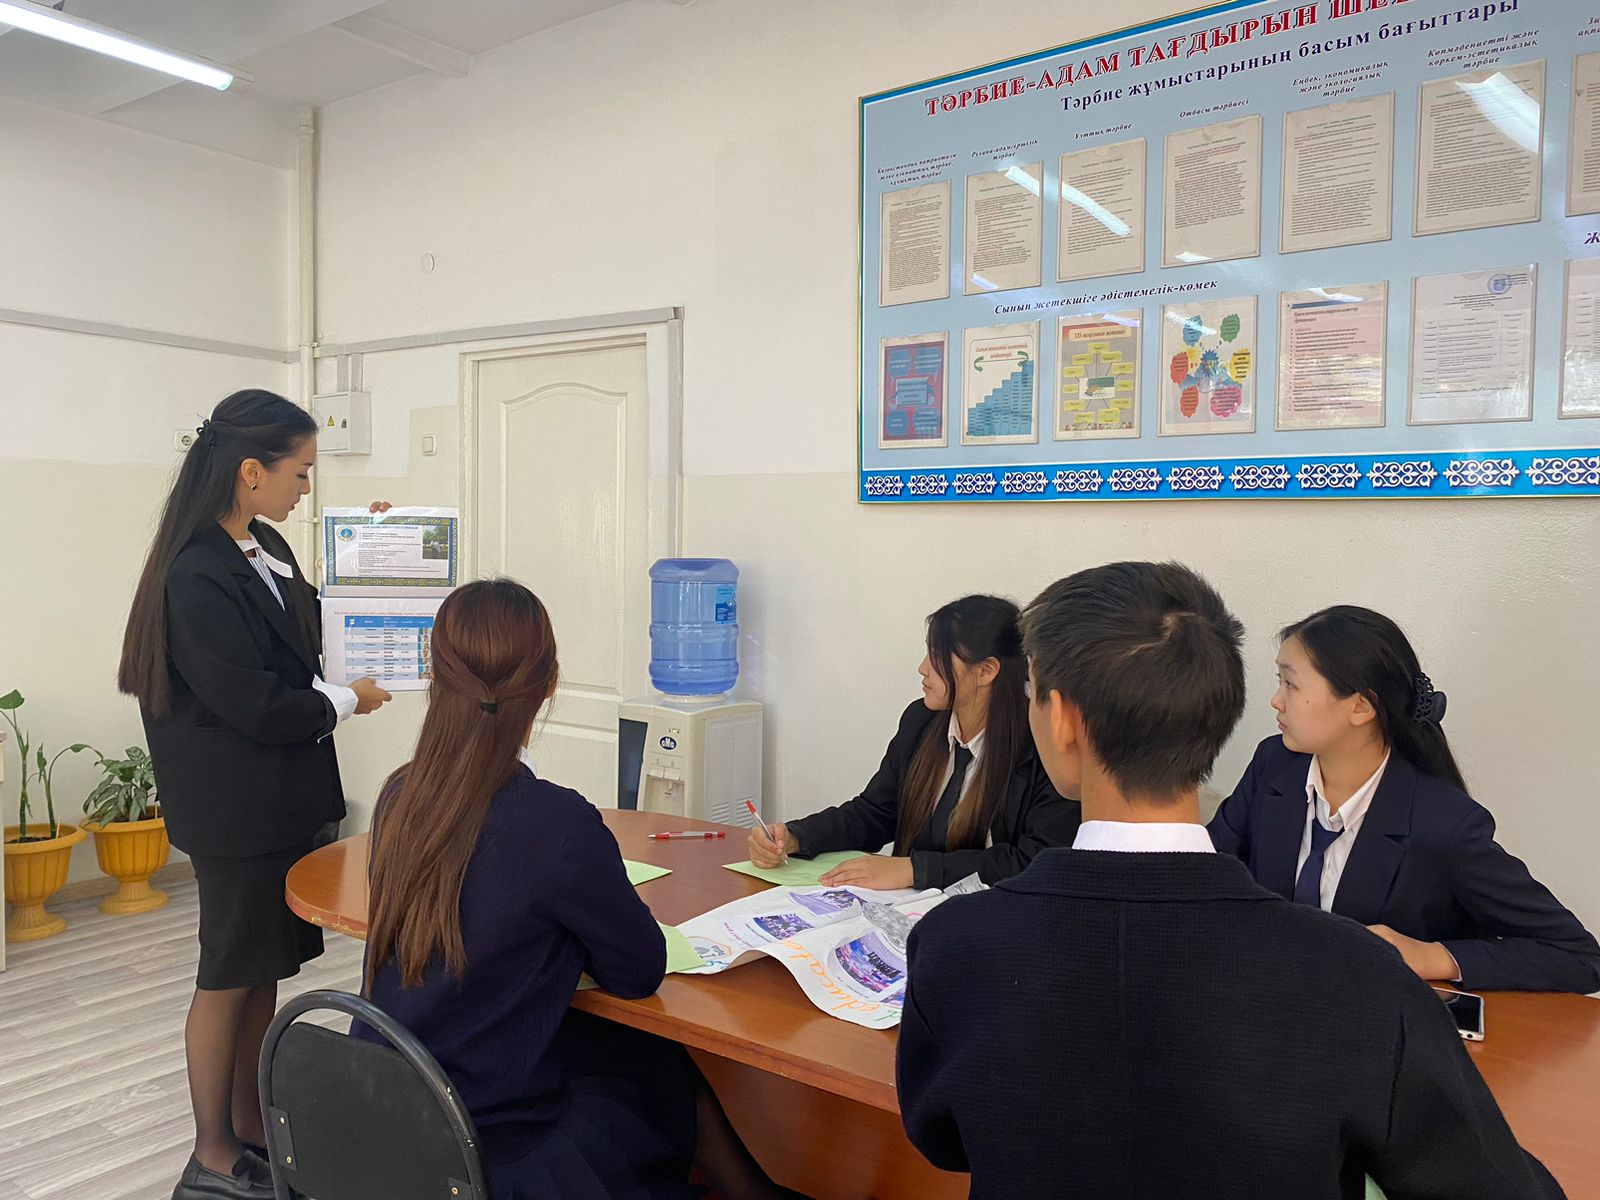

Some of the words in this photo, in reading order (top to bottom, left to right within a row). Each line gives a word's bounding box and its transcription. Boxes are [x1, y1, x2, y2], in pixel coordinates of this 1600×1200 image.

[924, 53, 1120, 116] ТӘРБИЕ-АДАМ
[1127, 3, 1318, 68] ТАҒДЫРЫН
[1061, 87, 1122, 111] Тәрбие
[1128, 50, 1292, 97] жұмыстарының
[1299, 32, 1370, 57] басым
[1378, 0, 1519, 40] бағыттары
[1463, 56, 1501, 69] тәрбие
[1322, 86, 1356, 98] тәрбие
[994, 302, 1031, 315] Сынып
[1034, 293, 1098, 309] жетекшіге
[1100, 279, 1218, 302] әдістемелік-көмек
